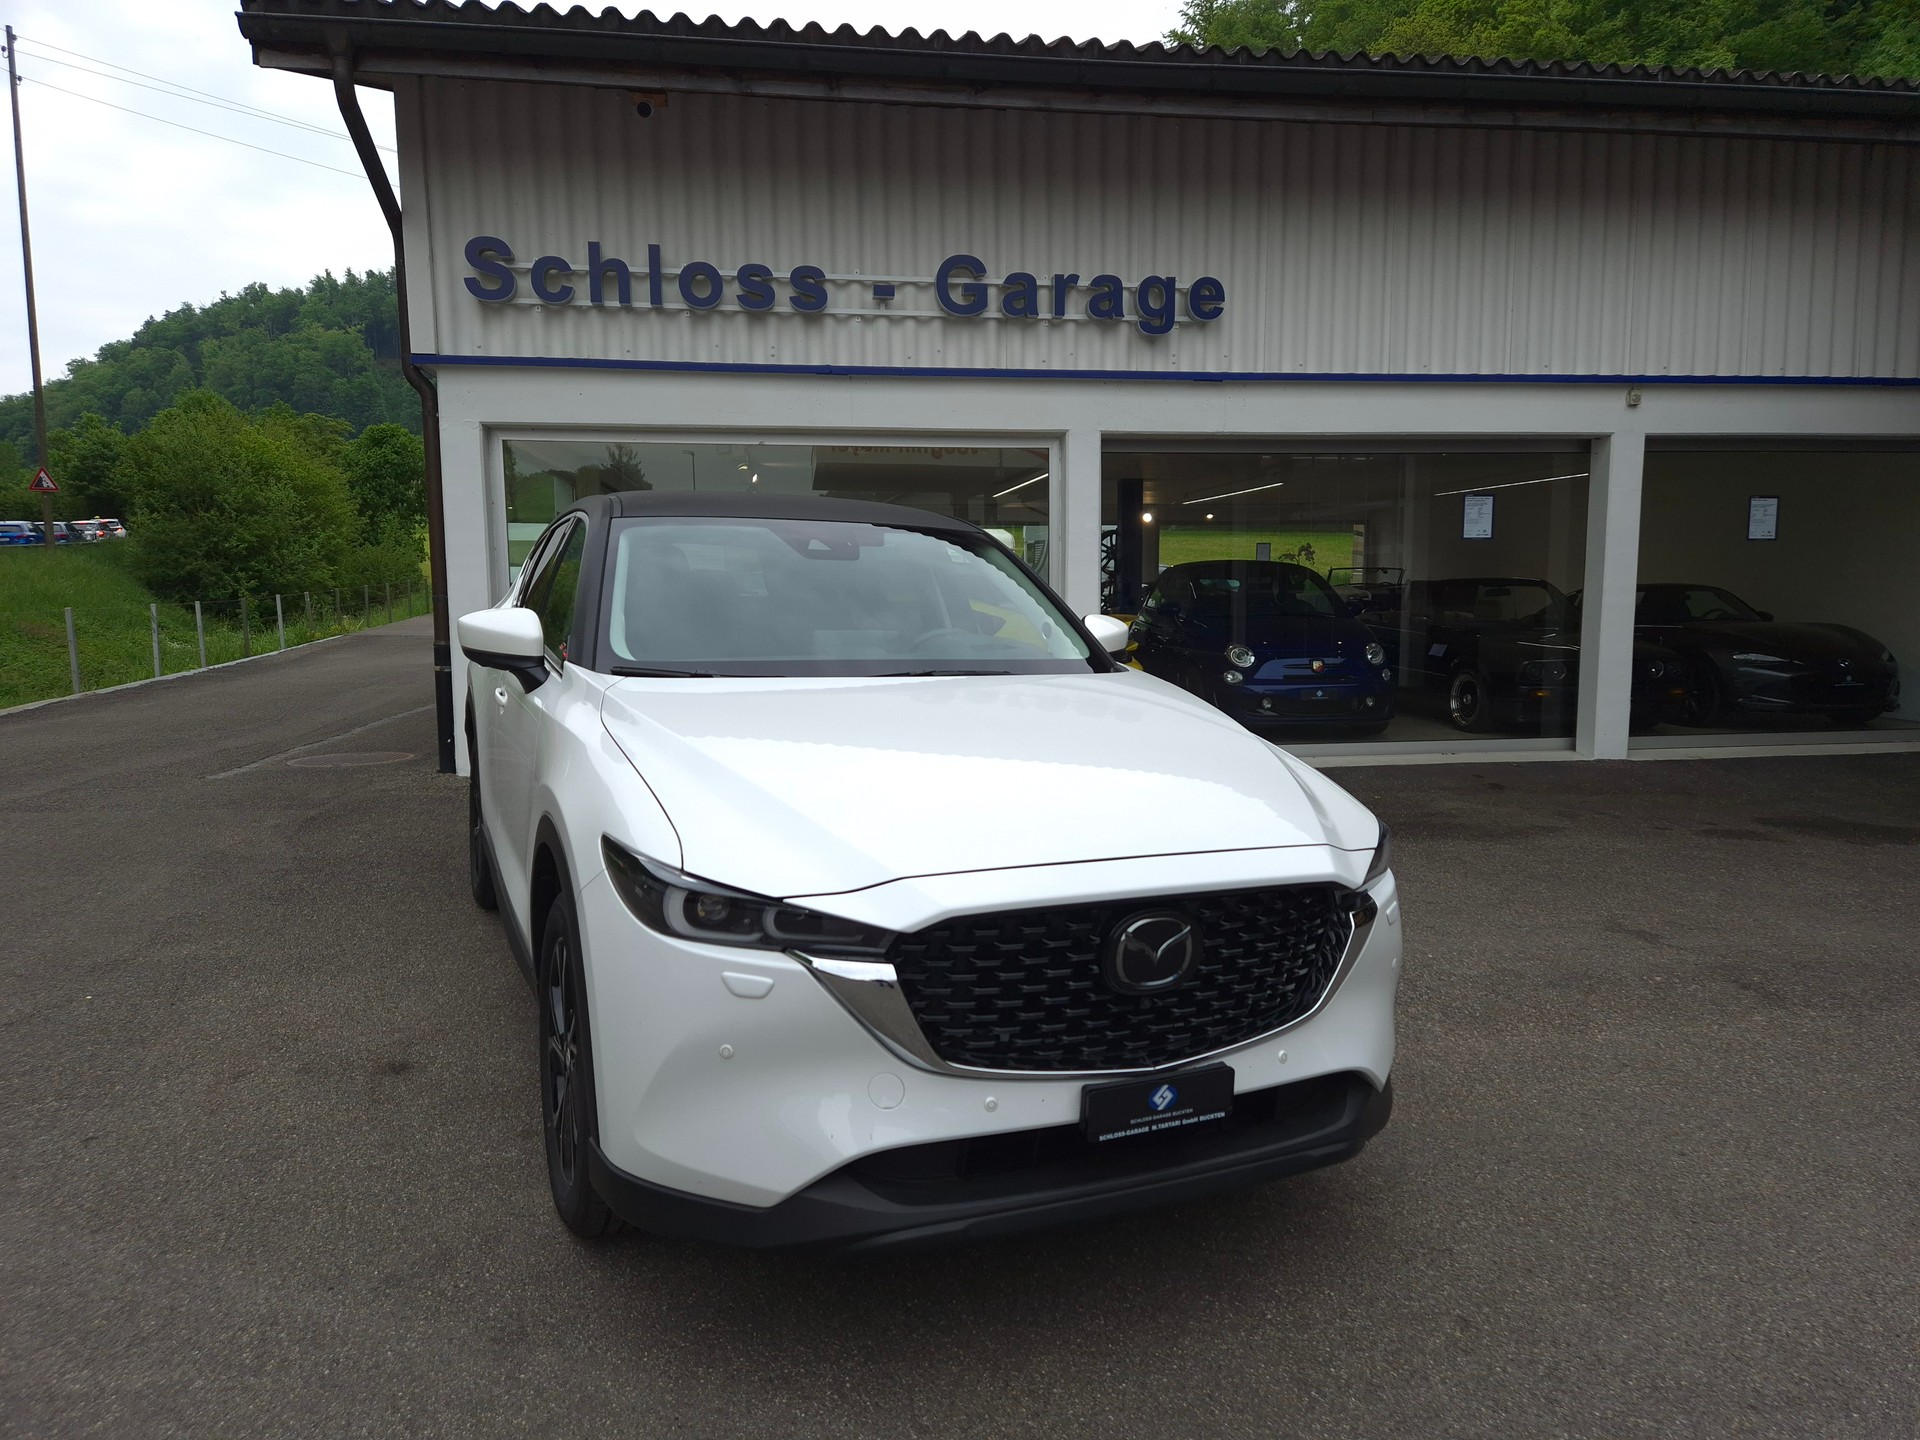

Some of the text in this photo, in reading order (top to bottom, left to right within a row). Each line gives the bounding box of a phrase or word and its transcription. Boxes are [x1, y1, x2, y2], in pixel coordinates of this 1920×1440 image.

[463, 236, 829, 314] Schloss
[934, 253, 1226, 336] Garage
[1099, 1126, 1150, 1142] SCHLOSS-GARAGE
[1182, 1116, 1199, 1125] GmbH
[1199, 1111, 1226, 1122] BUCKTEN
